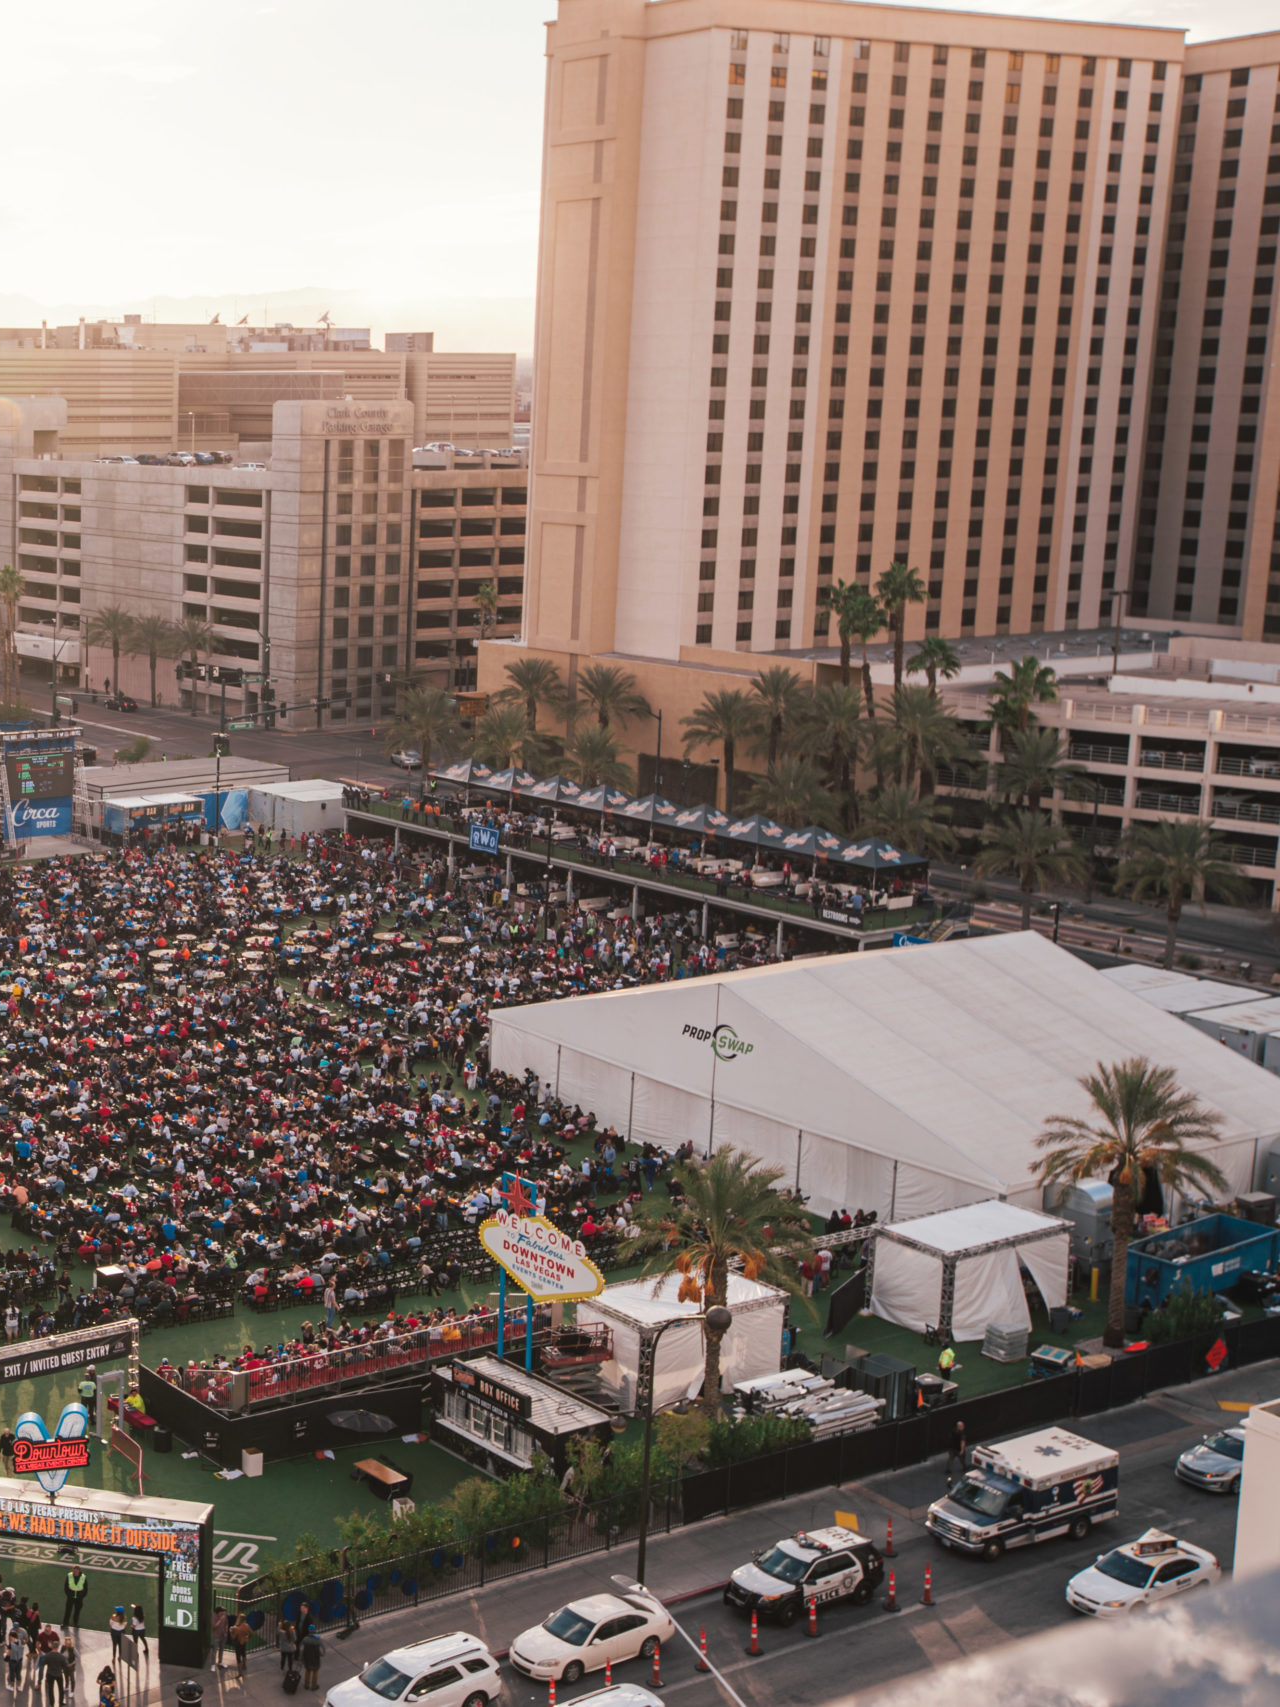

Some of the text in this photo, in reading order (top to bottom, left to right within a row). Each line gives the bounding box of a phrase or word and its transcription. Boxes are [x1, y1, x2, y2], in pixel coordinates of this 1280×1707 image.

[327, 407, 388, 420] Clark County
[322, 421, 393, 435] Parking Garage
[13, 798, 59, 827] Circa
[146, 807, 157, 816] BAR
[184, 803, 194, 812] BAR
[36, 820, 56, 829] SPORTS
[822, 908, 848, 924] RESTROOMS
[682, 1024, 754, 1055] PROP SWAP
[498, 1211, 582, 1257] WELCOME
[506, 1230, 516, 1239] TO
[517, 1233, 566, 1261] Fabulous
[503, 1240, 575, 1279] DOWNTOWN
[515, 1257, 561, 1281] LAS VEGAS
[512, 1264, 536, 1279] EVENTS
[539, 1275, 564, 1290] CENTER
[4, 1363, 21, 1378] EXIT
[30, 1356, 59, 1373] INVITED
[61, 1350, 84, 1366] GUEST
[86, 1344, 109, 1360] ENTRY
[480, 1380, 520, 1411] BOX OFFICE
[13, 1437, 88, 1462] Downtown
[8, 1502, 13, 1512] D
[15, 1502, 29, 1514] LAS
[32, 1504, 57, 1518] VEGAS
[59, 1508, 99, 1524] PRESENTS
[8, 1513, 27, 1532] WE
[30, 1515, 55, 1535] HAD
[59, 1519, 74, 1538] TO
[76, 1521, 108, 1543] TAKE
[111, 1526, 123, 1544] IT
[125, 1528, 181, 1553] OUTSIDE.
[61, 1551, 151, 1572] EVENTS
[172, 1560, 191, 1573] FREE
[179, 1572, 197, 1582] EVENT
[170, 1594, 177, 1602] AT
[172, 1585, 191, 1595] DOORS
[805, 1588, 841, 1608] POLICE
[177, 1609, 193, 1627] D
